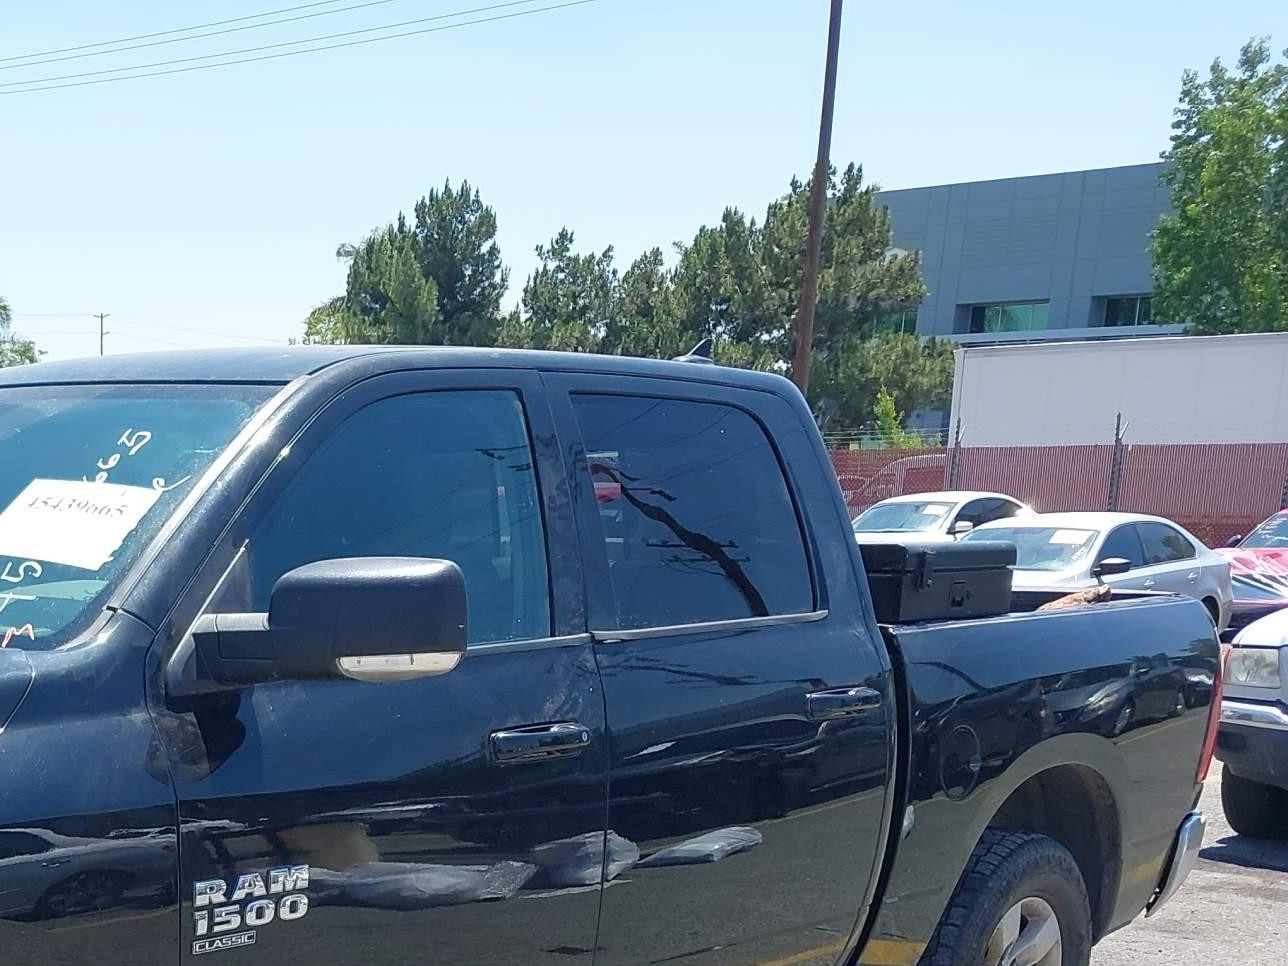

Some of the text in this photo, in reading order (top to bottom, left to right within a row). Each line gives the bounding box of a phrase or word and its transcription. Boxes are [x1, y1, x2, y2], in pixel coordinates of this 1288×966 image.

[193, 864, 310, 908] RAM
[193, 894, 310, 937] 1500
[195, 933, 255, 953] CLASSIC
